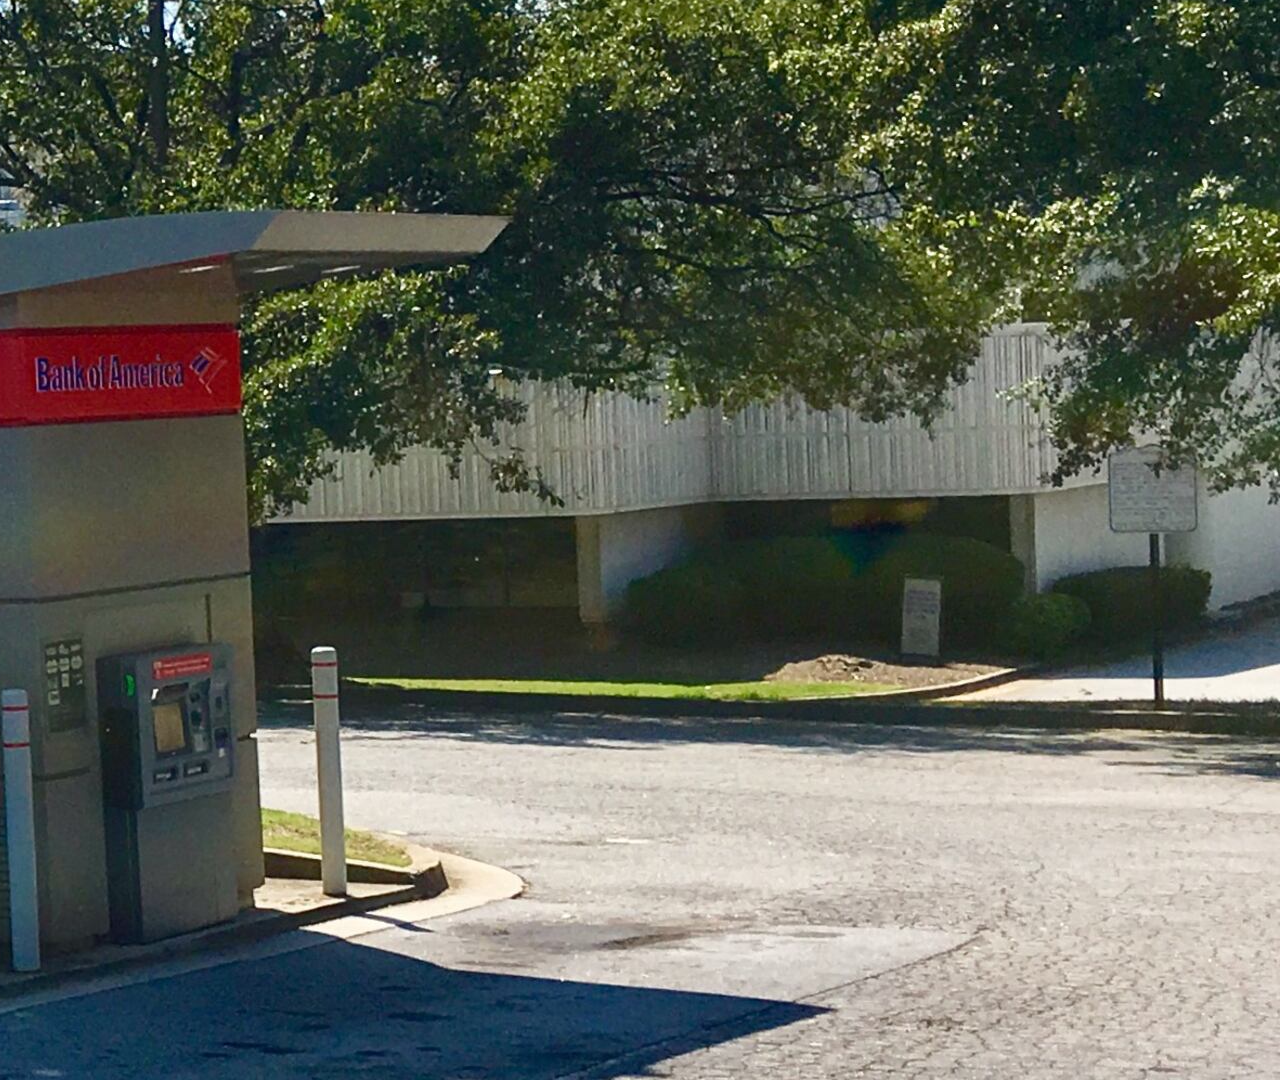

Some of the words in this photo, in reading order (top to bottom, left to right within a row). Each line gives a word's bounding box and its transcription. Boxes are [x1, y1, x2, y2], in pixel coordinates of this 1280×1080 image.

[35, 356, 83, 392] Bank
[87, 355, 105, 391] of
[108, 353, 184, 390] America
